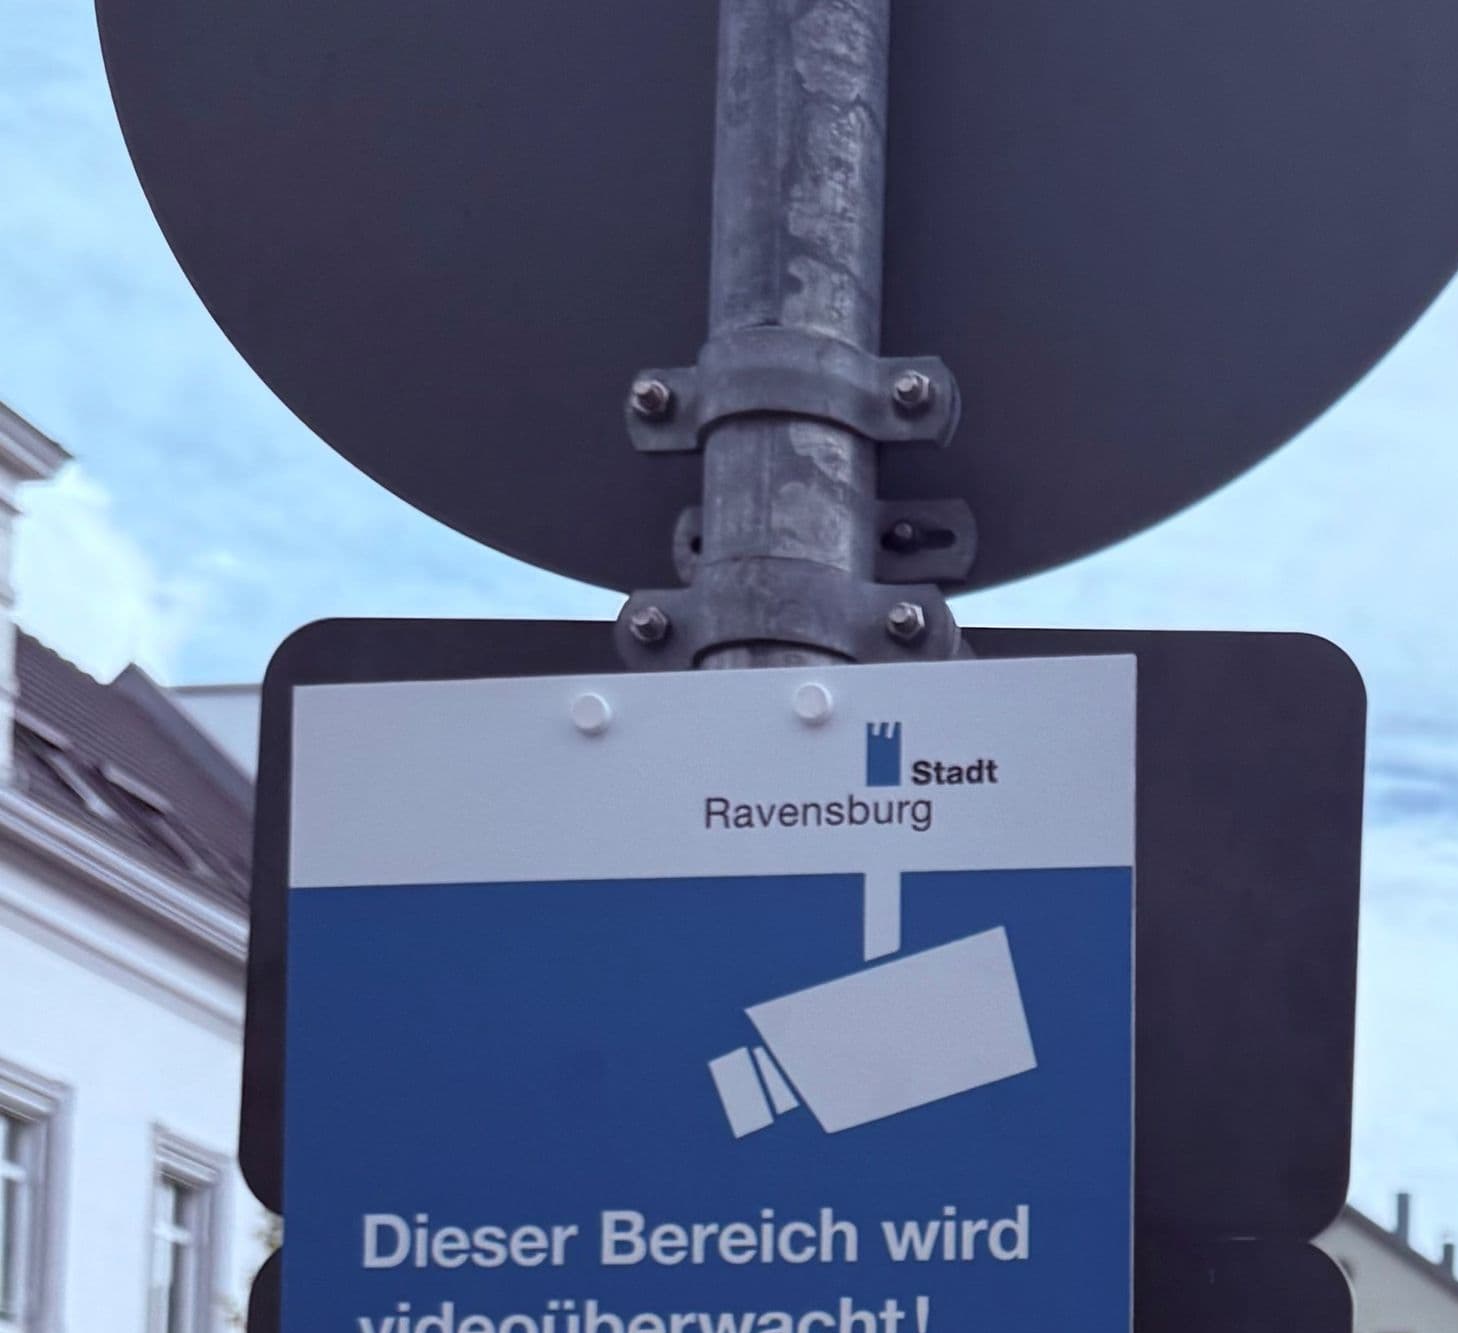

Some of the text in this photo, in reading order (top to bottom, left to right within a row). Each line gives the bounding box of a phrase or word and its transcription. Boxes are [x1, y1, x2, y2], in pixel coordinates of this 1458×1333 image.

[911, 759, 998, 785] Stadt
[704, 794, 933, 831] Ravensburg
[361, 1204, 1031, 1269] Dieser Bereich wird
